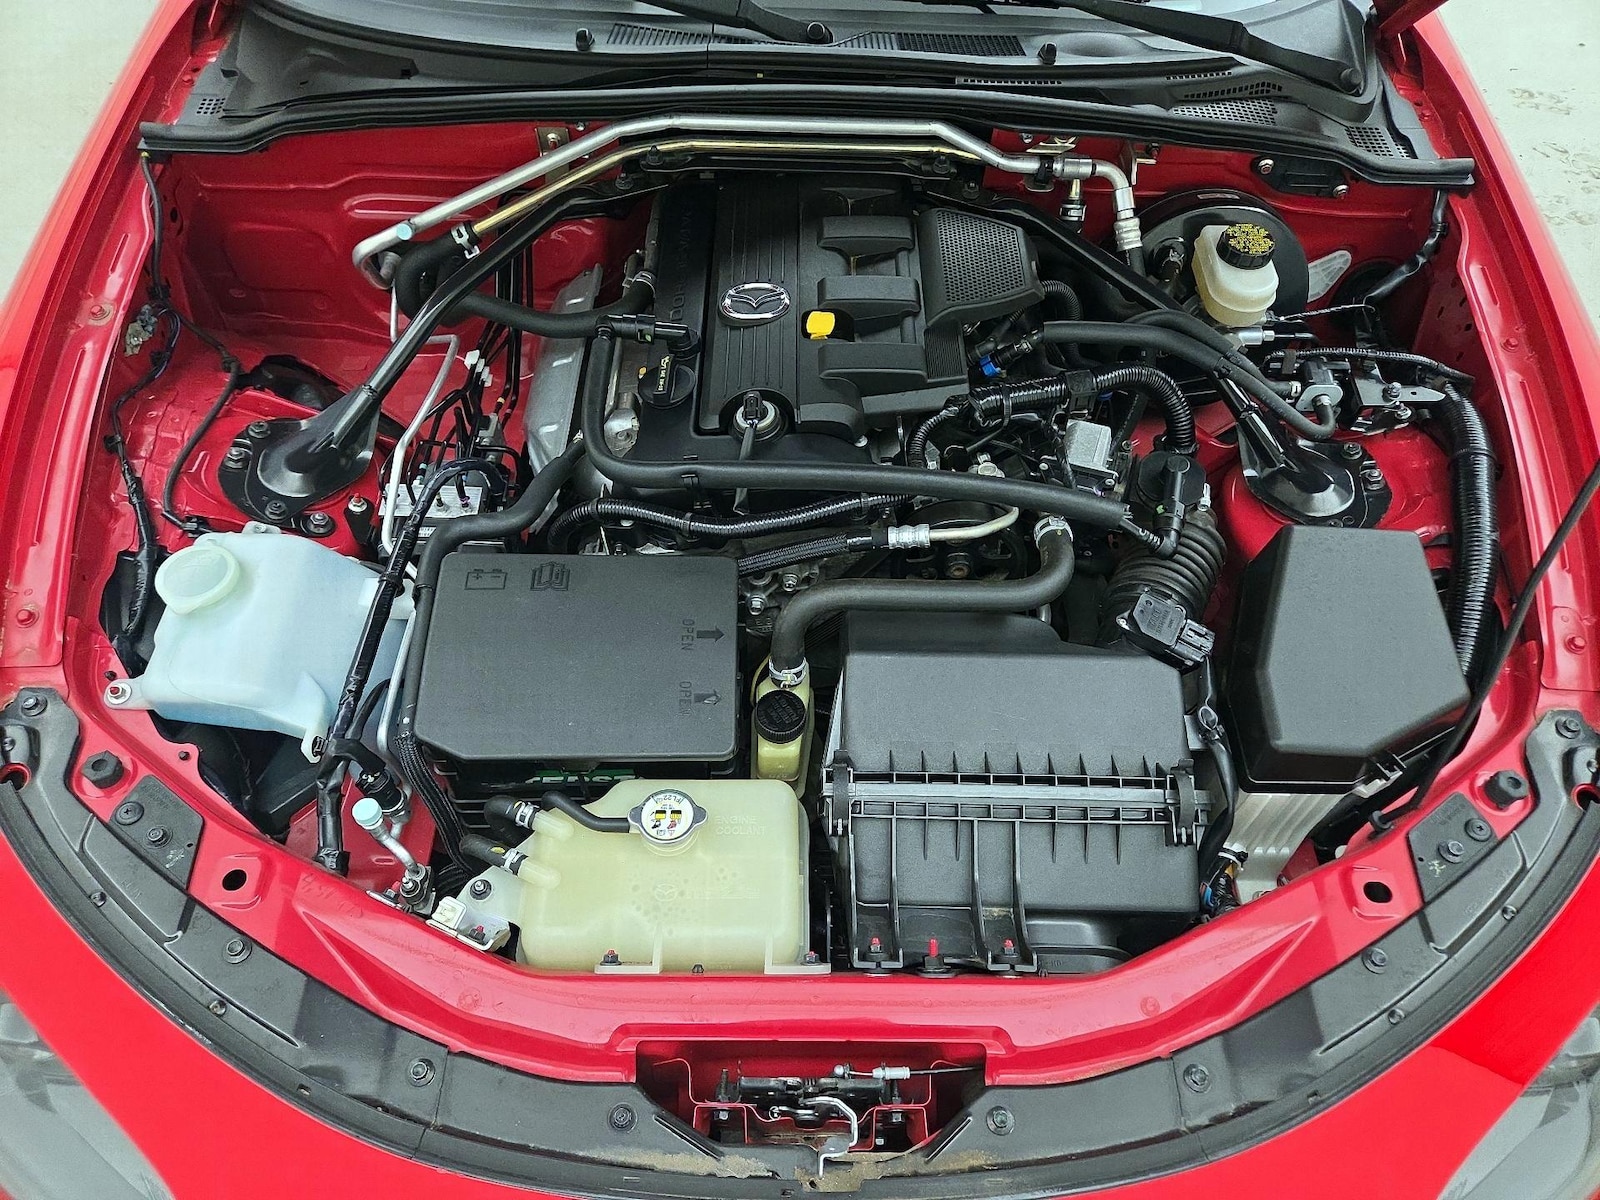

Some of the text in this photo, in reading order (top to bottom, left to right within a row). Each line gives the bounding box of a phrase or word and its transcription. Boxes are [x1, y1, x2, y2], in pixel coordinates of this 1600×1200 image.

[680, 618, 695, 651] OPEN
[678, 680, 693, 717] OPEN
[662, 794, 681, 803] FL22
[715, 815, 759, 825] ENGINE
[716, 825, 766, 835] COOLANT
